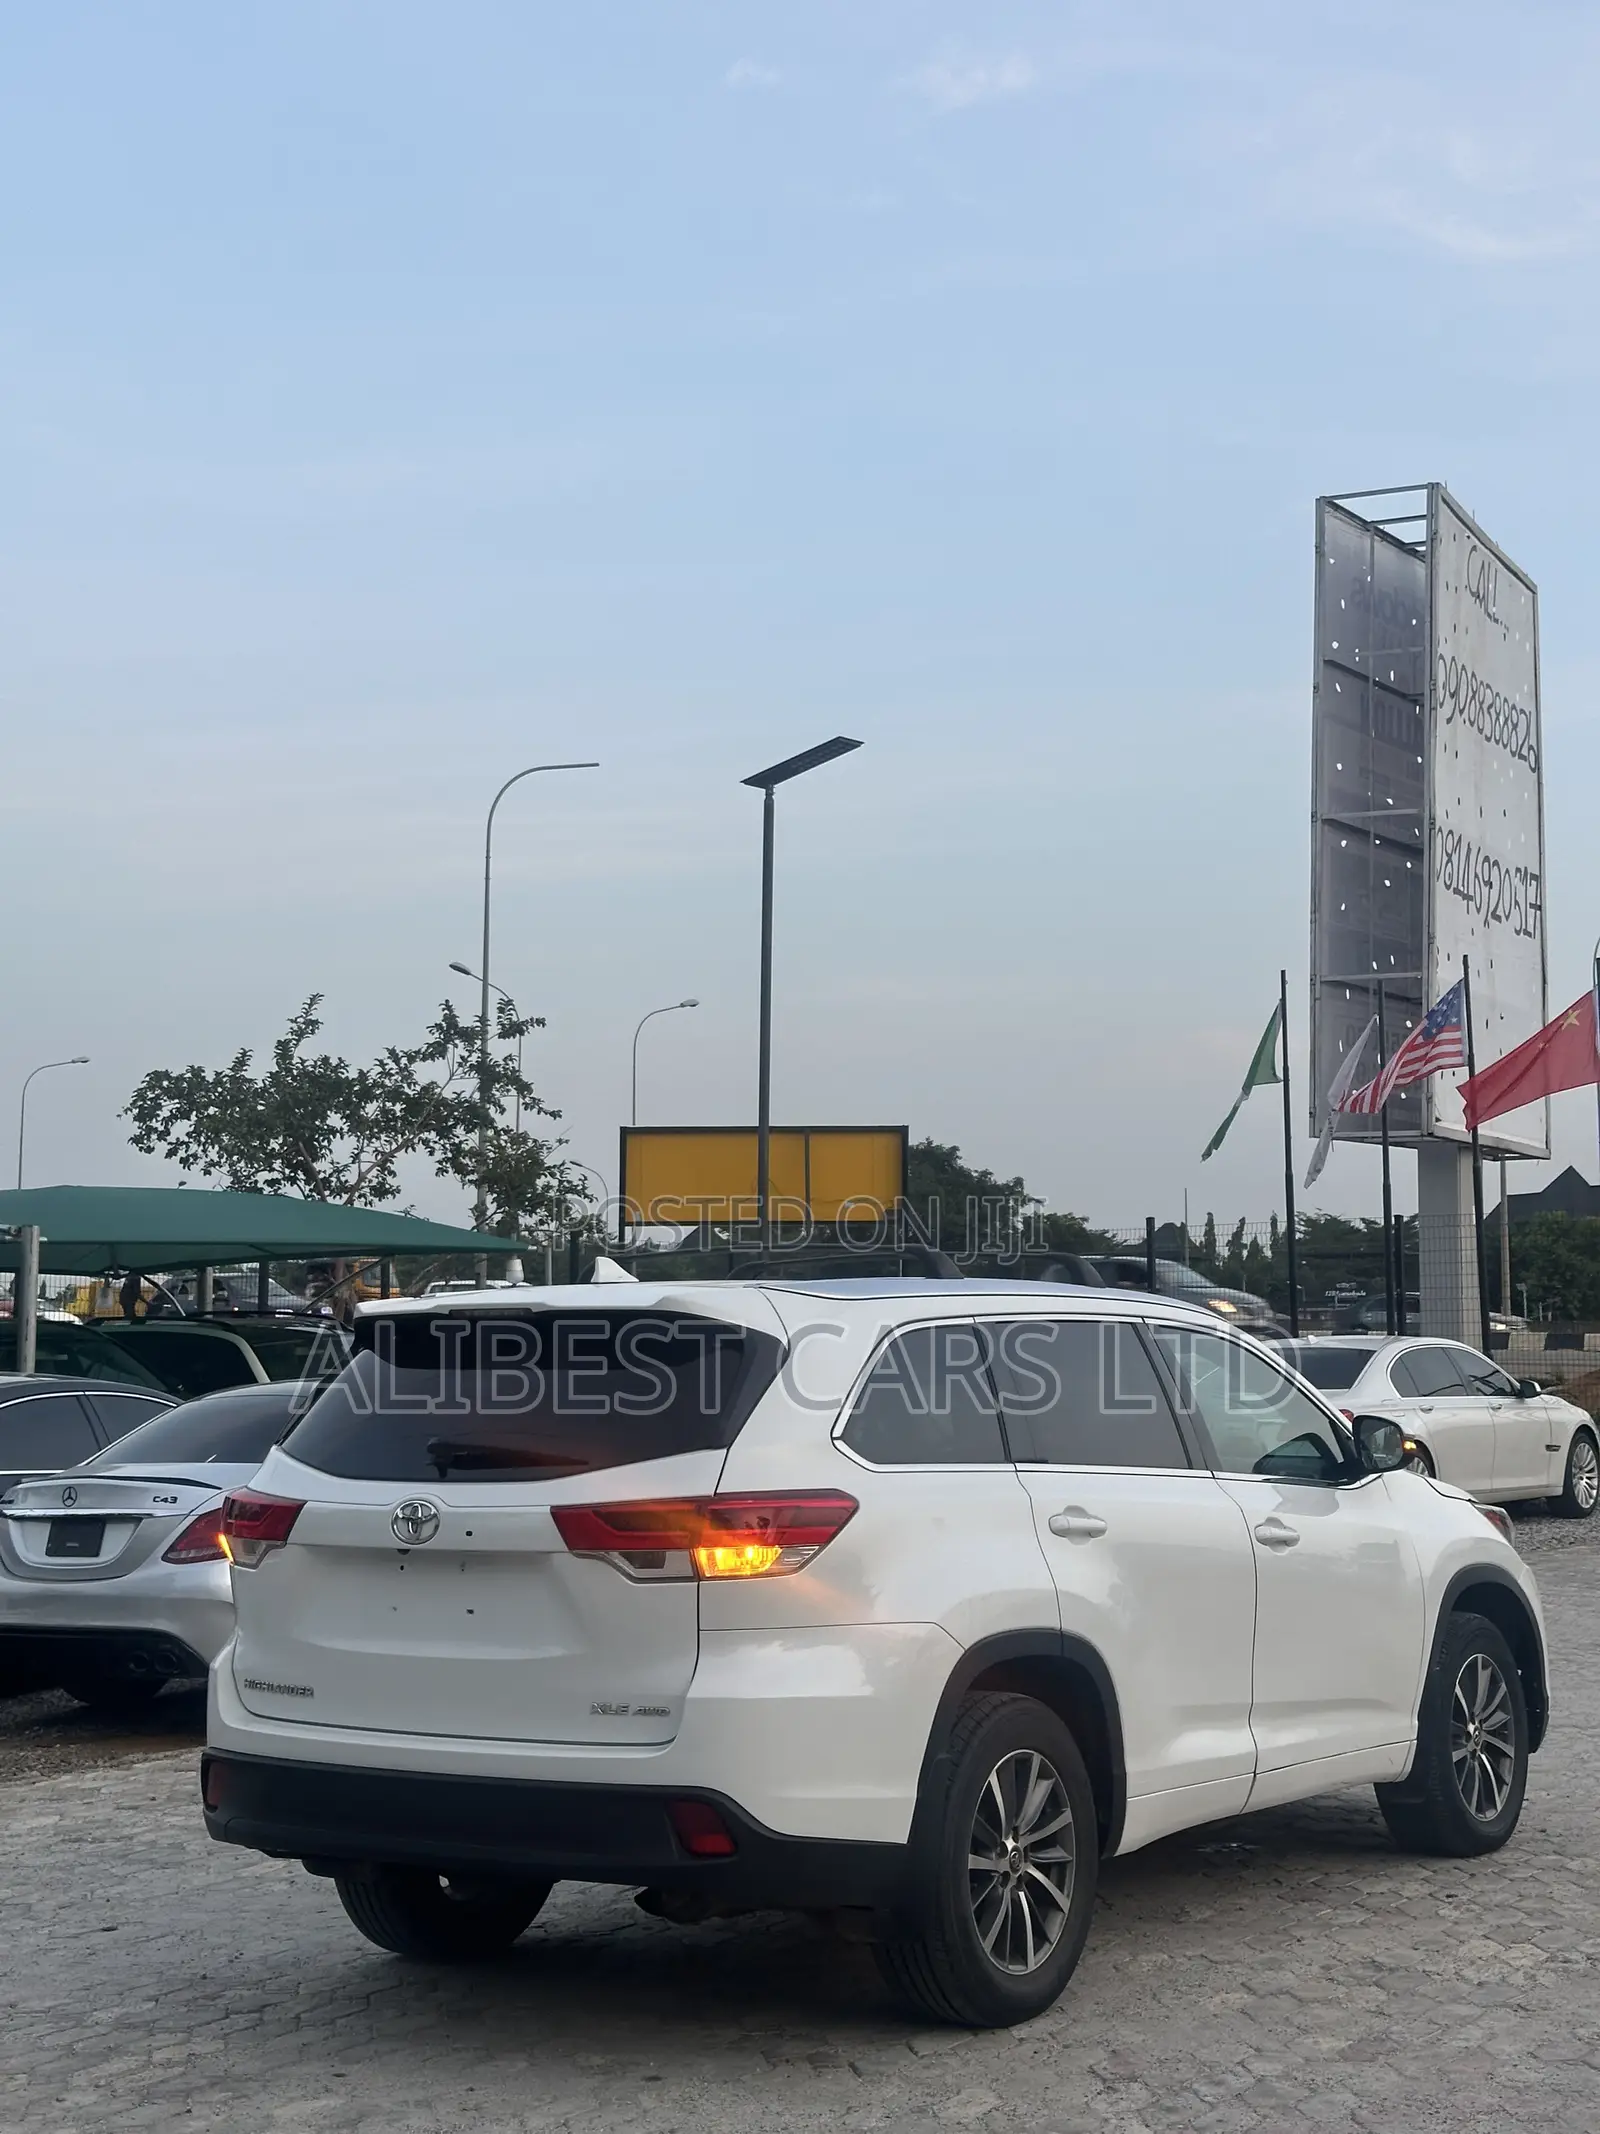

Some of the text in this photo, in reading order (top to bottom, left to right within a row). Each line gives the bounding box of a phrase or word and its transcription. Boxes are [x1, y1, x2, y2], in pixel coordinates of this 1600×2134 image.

[153, 1496, 178, 1504] C43
[244, 1679, 314, 1698] HIGHLANDER
[590, 1702, 670, 1716] XLE AWD
